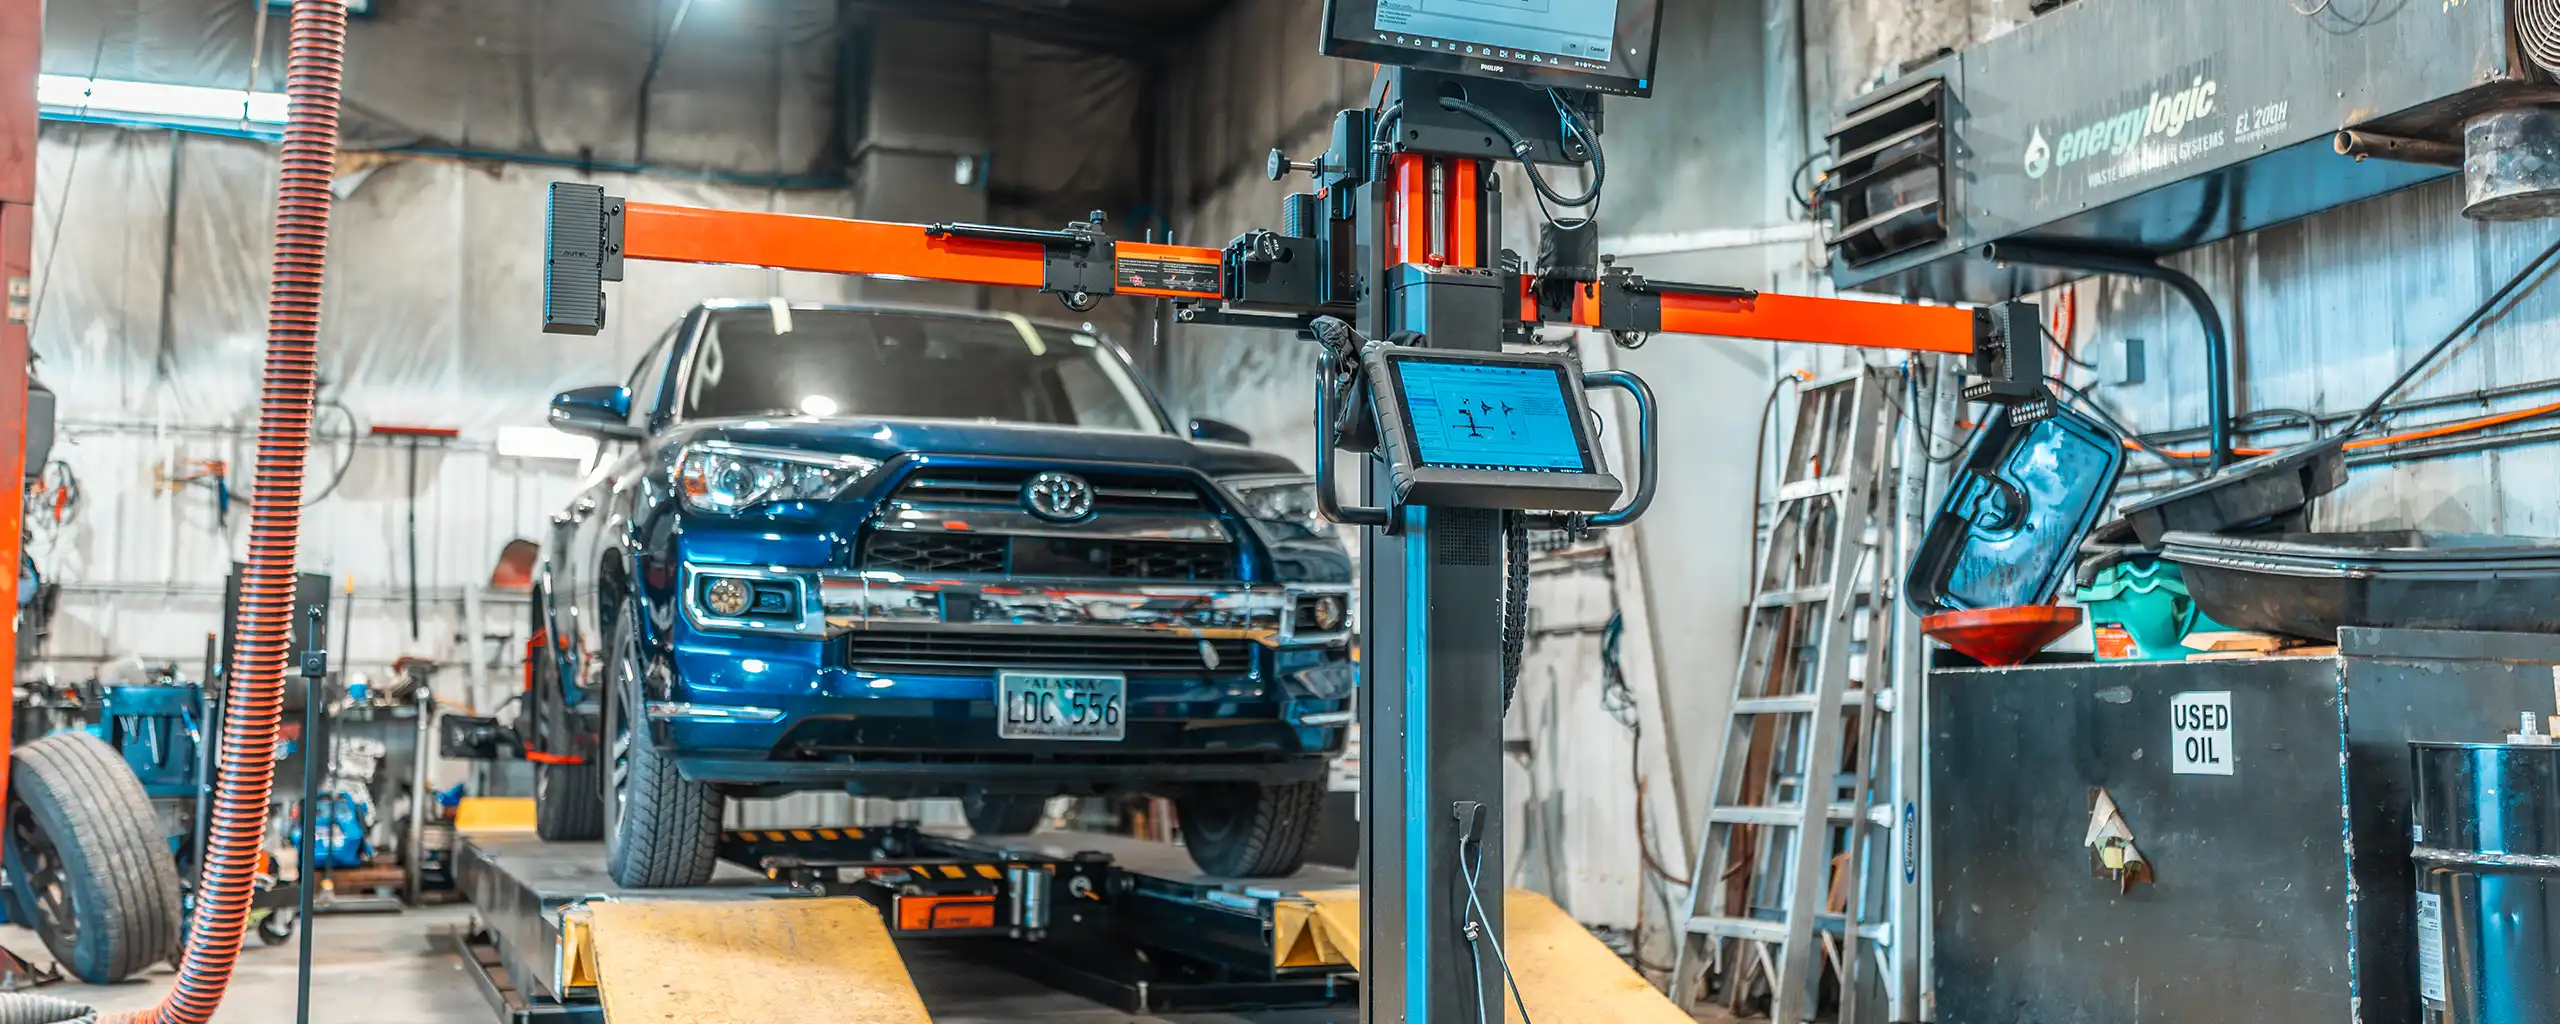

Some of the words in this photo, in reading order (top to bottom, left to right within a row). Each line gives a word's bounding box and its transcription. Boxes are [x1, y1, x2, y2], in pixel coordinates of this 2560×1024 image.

[1480, 63, 1504, 73] PHILIPS
[2055, 74, 2216, 167] energylogic
[2235, 110, 2250, 135] EL
[2179, 130, 2225, 161] SYSTEMS
[1032, 679, 1096, 691] ALASKA
[1007, 690, 1055, 724] LDC
[1072, 692, 1119, 725] 556
[2174, 704, 2229, 731] USED
[2185, 736, 2220, 764] OIL
